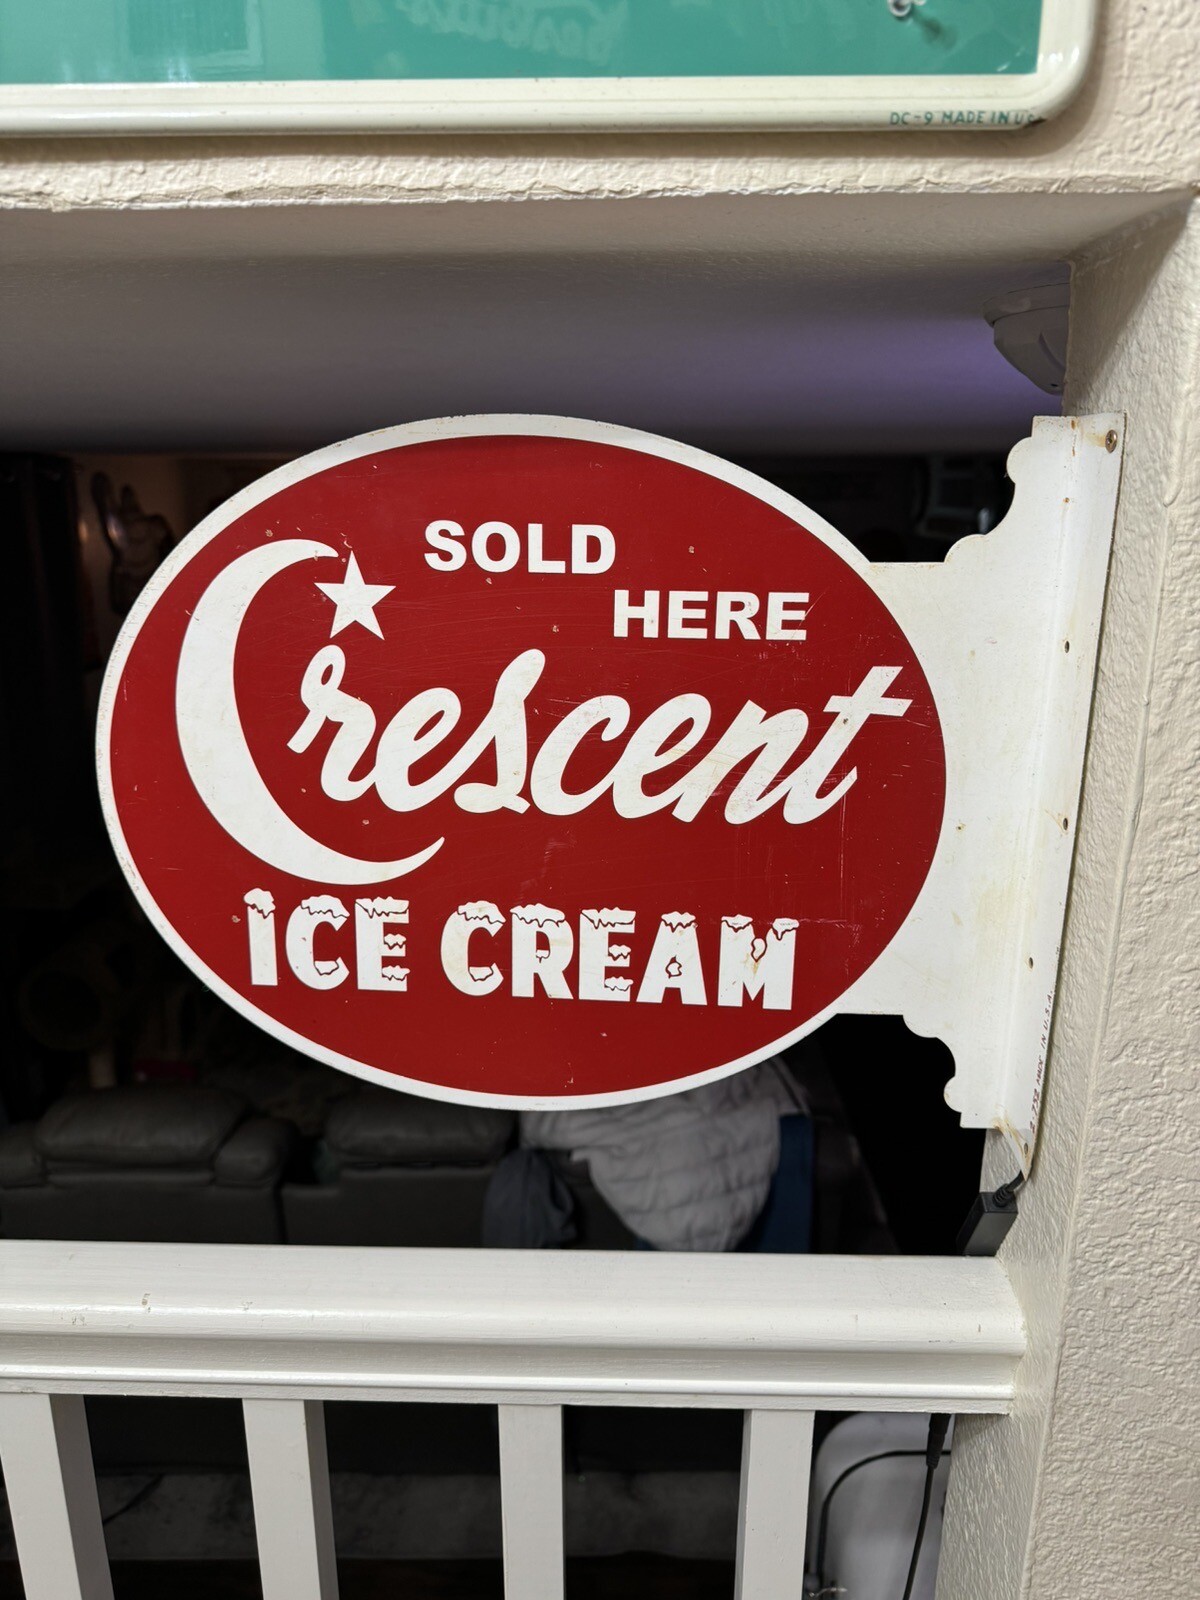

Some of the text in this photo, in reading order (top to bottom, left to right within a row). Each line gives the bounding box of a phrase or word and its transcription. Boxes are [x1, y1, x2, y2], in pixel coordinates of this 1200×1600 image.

[889, 111, 933, 125] DC-9
[941, 111, 985, 125] MADE
[990, 111, 1010, 125] IN
[424, 520, 616, 574] SOLD
[613, 589, 810, 640] HERE
[243, 887, 800, 1011] ICE CREAM
